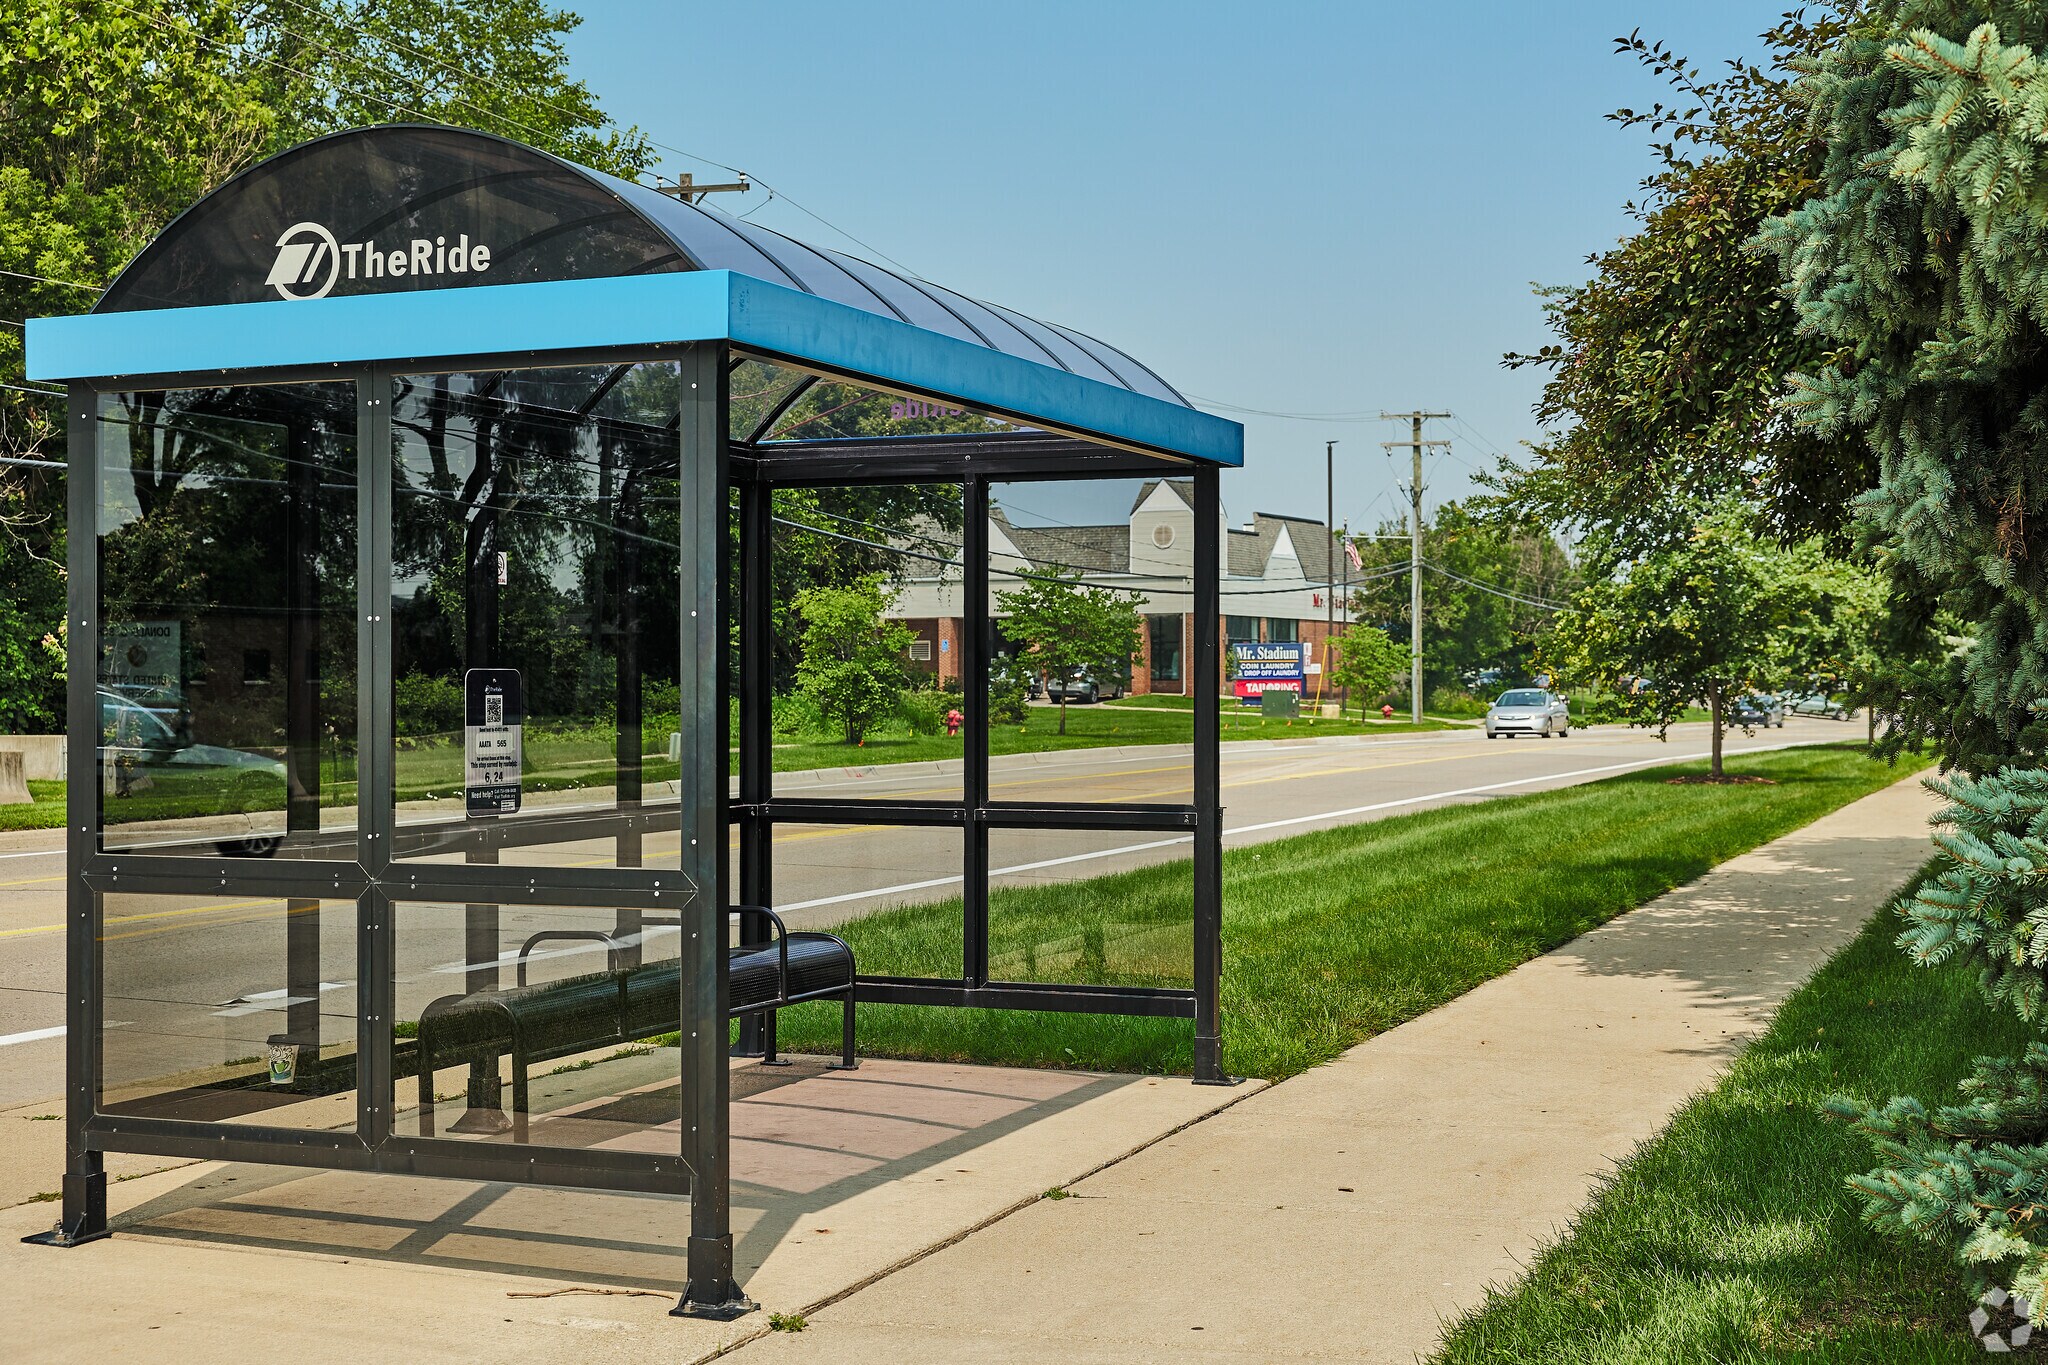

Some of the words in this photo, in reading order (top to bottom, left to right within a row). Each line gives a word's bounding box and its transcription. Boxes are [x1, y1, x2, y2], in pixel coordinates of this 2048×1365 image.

[341, 234, 491, 279] TheRide
[1236, 646, 1256, 660] Mr.
[1257, 646, 1299, 660] Stadium
